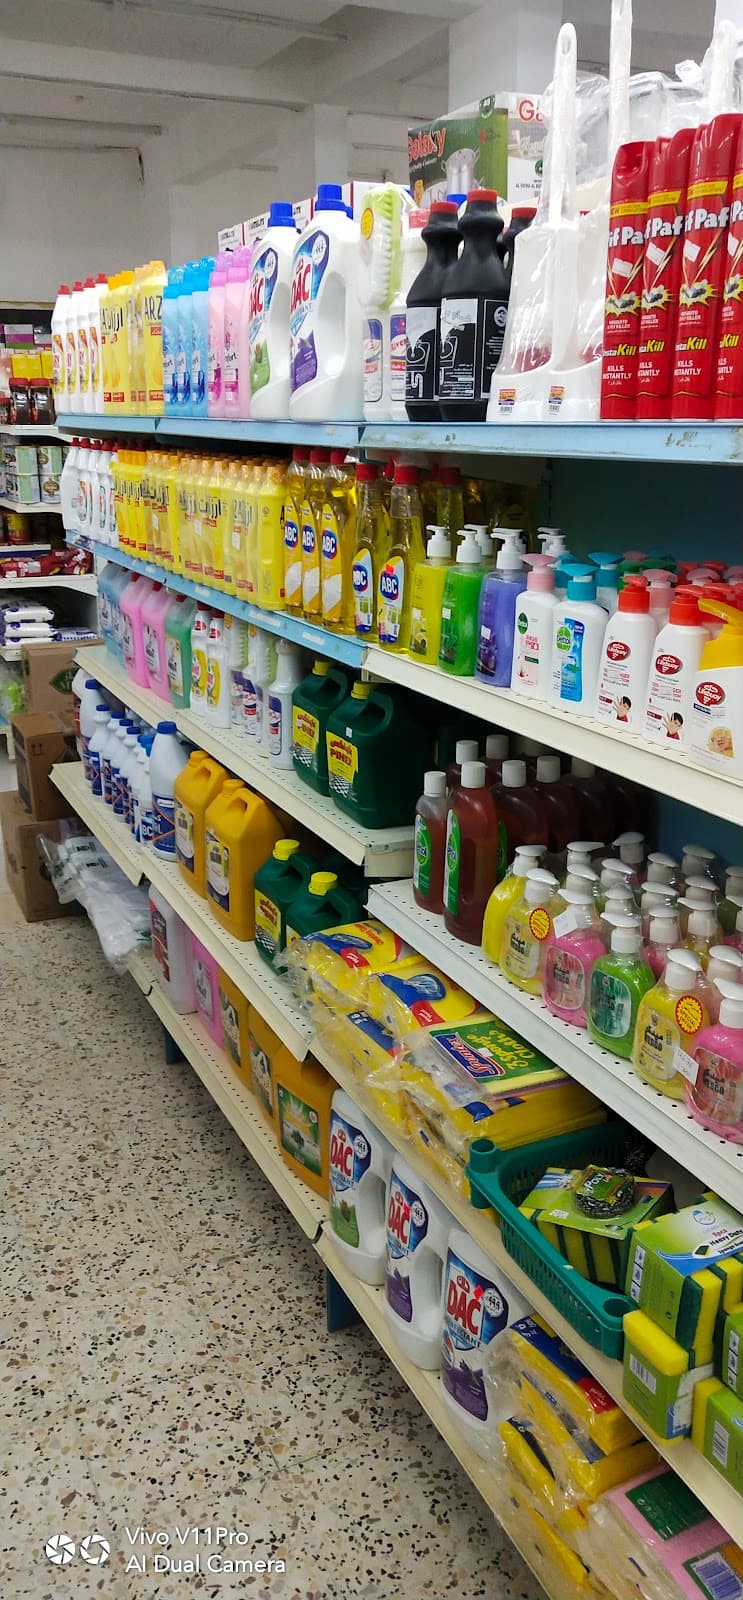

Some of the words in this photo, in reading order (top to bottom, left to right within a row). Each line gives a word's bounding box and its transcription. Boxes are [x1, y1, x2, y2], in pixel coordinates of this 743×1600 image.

[518, 99, 544, 122] Ga
[651, 213, 684, 238] Paf
[694, 207, 730, 230] Paf
[621, 226, 644, 245] Pa
[284, 525, 298, 542] ABC
[302, 530, 315, 548] ABC
[322, 535, 336, 554] ABC
[352, 569, 367, 587] ABC
[381, 576, 398, 595] ABC
[656, 659, 680, 670] Lifebuoy
[697, 686, 722, 702] Lifebuoy
[466, 1033, 518, 1063] Sponge
[330, 1134, 353, 1178] DAC
[388, 1196, 412, 1245] DAC
[709, 1235, 730, 1246] Heavy
[446, 1279, 482, 1336] DAC
